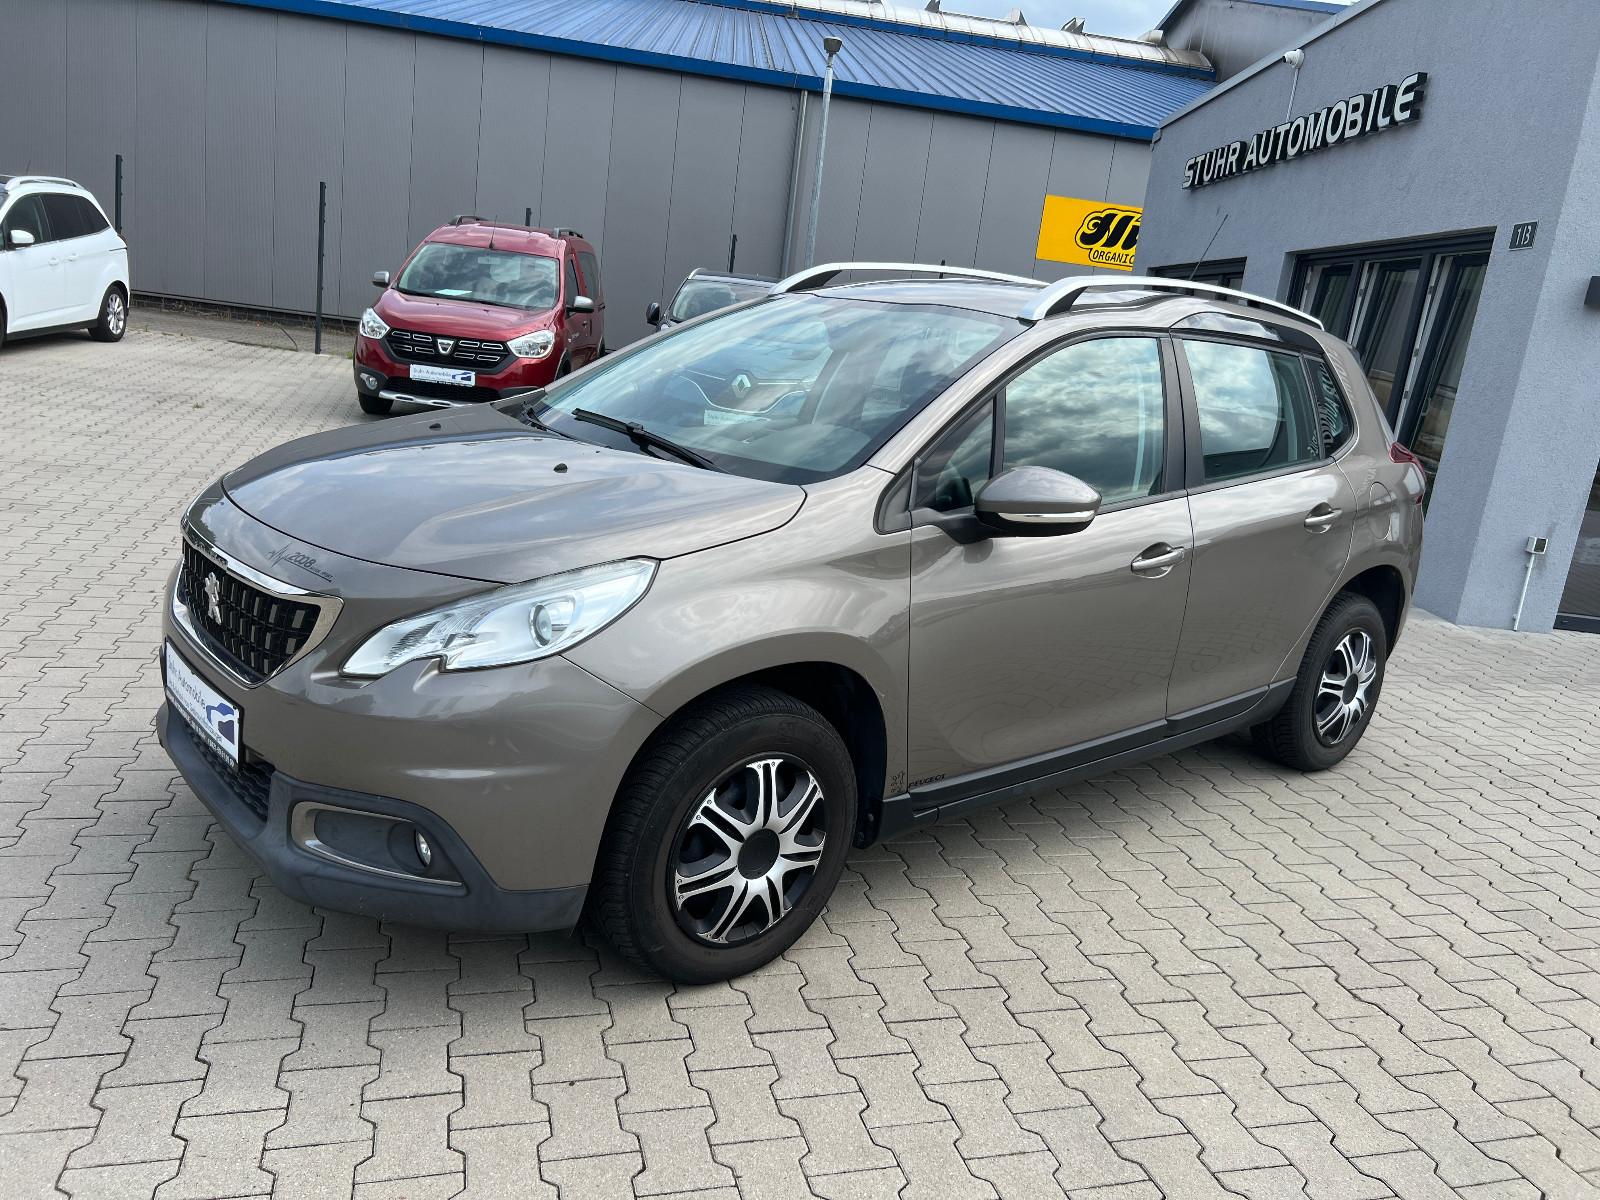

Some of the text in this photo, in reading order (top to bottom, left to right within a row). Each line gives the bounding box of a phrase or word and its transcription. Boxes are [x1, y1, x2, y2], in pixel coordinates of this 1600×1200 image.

[1183, 72, 1422, 188] STUHR AUTOMOBILE
[287, 551, 317, 568] 2008
